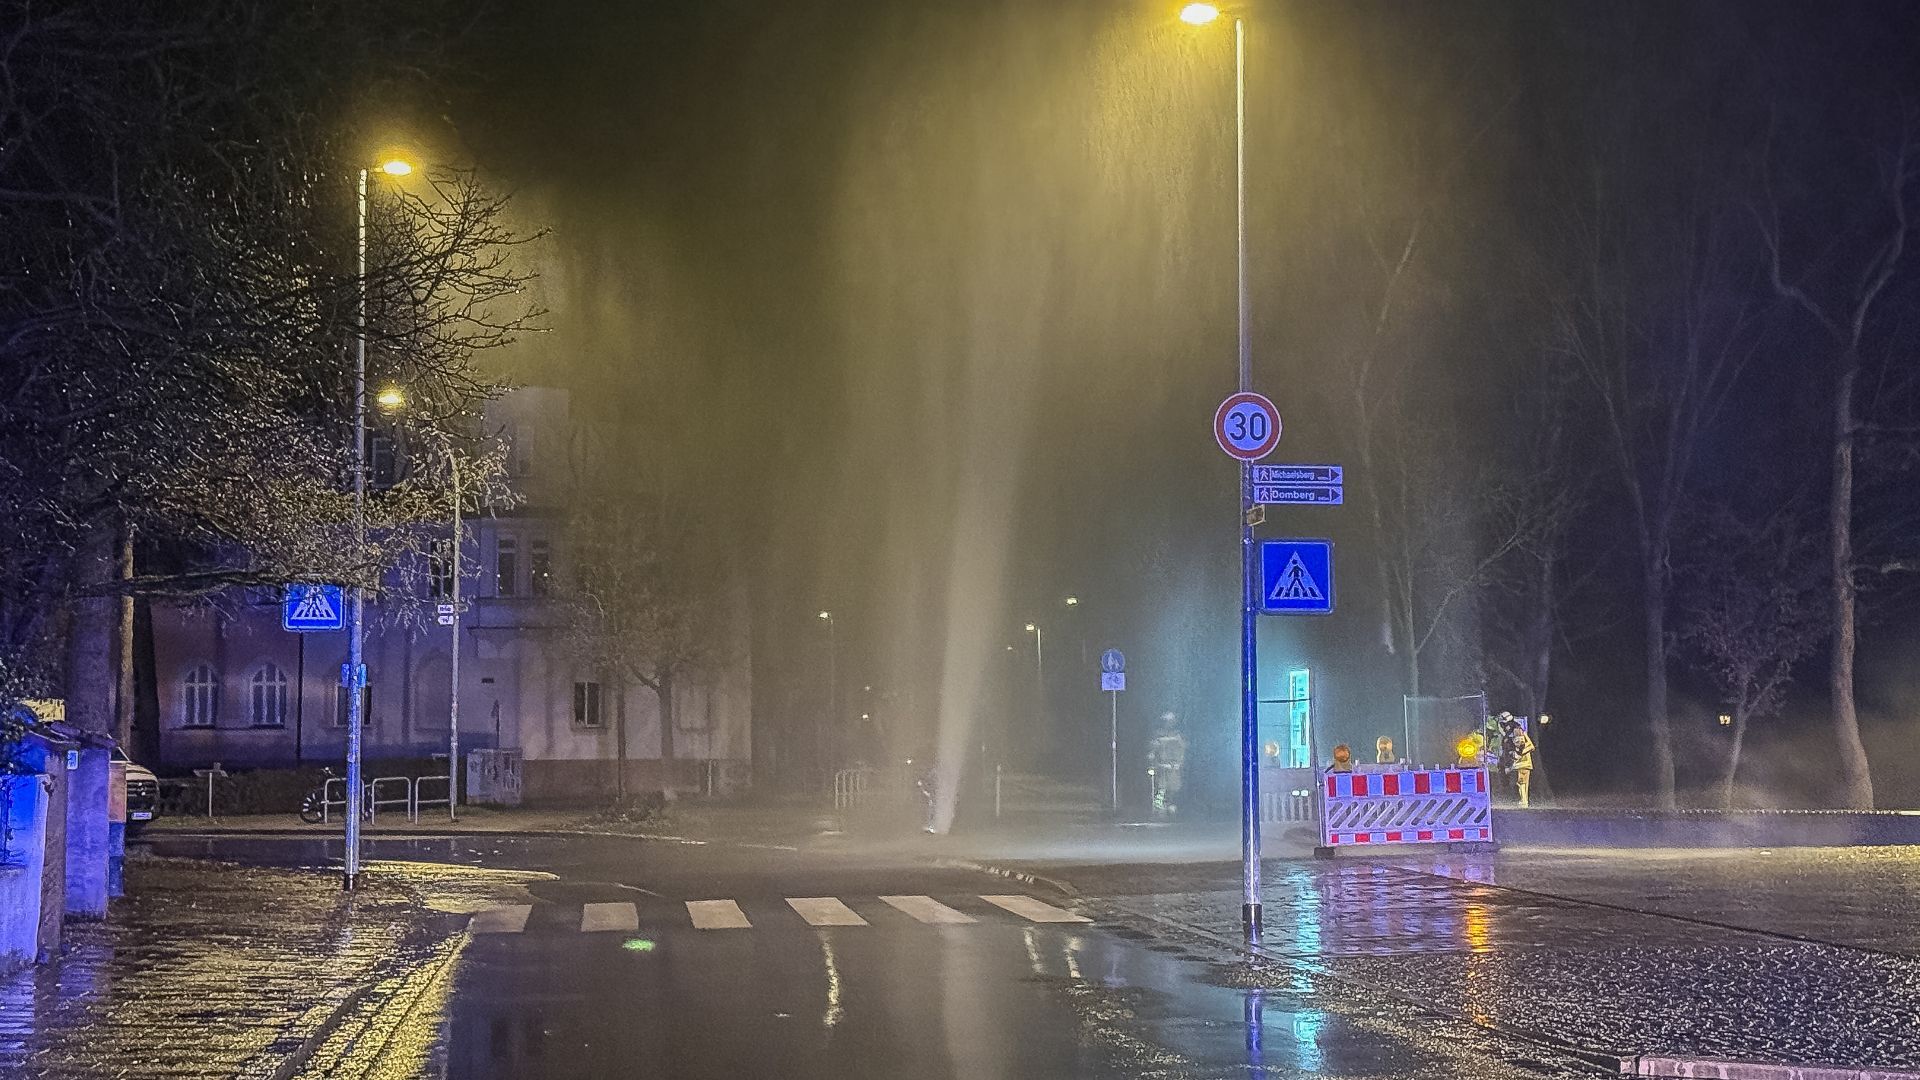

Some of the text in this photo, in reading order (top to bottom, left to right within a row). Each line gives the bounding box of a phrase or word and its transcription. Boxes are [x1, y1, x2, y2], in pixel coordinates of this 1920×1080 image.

[1230, 412, 1266, 441] 30
[1272, 470, 1315, 480] Michaelsberg
[1272, 490, 1315, 500] Domberg
